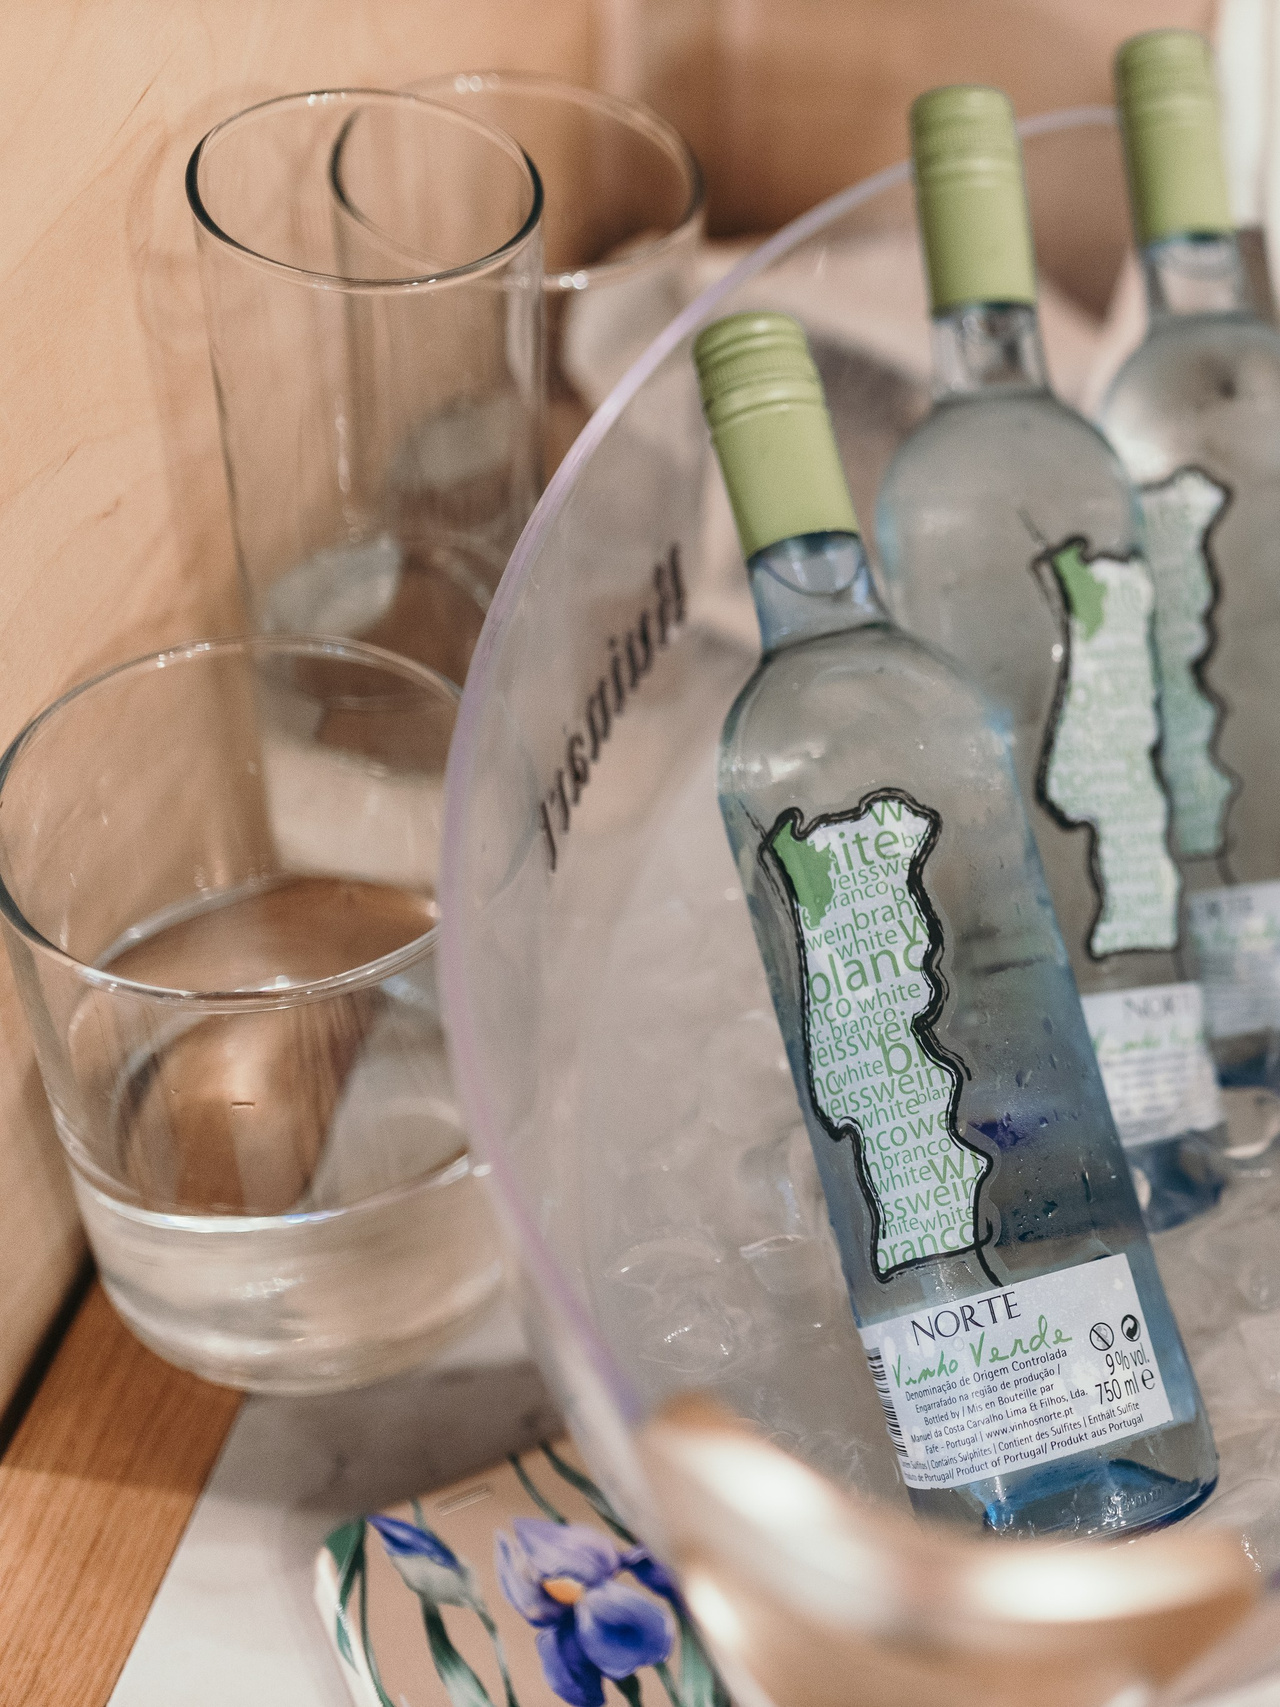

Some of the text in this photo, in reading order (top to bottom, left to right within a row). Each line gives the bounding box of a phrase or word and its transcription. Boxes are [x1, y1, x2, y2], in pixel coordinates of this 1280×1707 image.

[827, 881, 889, 912] ranco
[833, 857, 912, 890] eisswe
[857, 983, 921, 1013] white
[880, 1217, 920, 1241] hite
[911, 1291, 1021, 1346] NORTE
[892, 1314, 1073, 1388] Vinho Verde
[905, 1348, 1068, 1402] Denominação de Origem Controlada
[915, 1396, 957, 1414] Engarrafado
[959, 1394, 969, 1402] na
[971, 1384, 998, 1398] região
[1000, 1381, 1011, 1390] de
[1013, 1368, 1055, 1388] produção
[1094, 1379, 1122, 1405] 750
[1124, 1371, 1140, 1396] ml
[911, 1431, 932, 1443] Manuel
[934, 1429, 943, 1438] da
[943, 1424, 965, 1435] Costa
[966, 1414, 1004, 1429] Carvalho
[1005, 1406, 1028, 1418] Lima
[1039, 1394, 1069, 1408] Filhos,
[1069, 1388, 1088, 1400] Lda.
[924, 1412, 949, 1426] Bottled
[950, 1411, 960, 1420] by
[966, 1403, 983, 1414] Mis
[985, 1400, 996, 1409] en
[997, 1388, 1038, 1406] Bouteille
[1040, 1383, 1055, 1395] par
[925, 1444, 939, 1454] Fafe
[946, 1433, 978, 1449] Portugal
[985, 1406, 1074, 1438] www.vinhosnorte.pt
[931, 1456, 958, 1469] Contains
[958, 1447, 992, 1462] Sulphites
[998, 1435, 1033, 1451] Contient
[1035, 1430, 1050, 1441] des
[1050, 1421, 1082, 1436] Sulfites
[1116, 1402, 1140, 1416] Sulfite
[956, 1461, 989, 1476] Product
[991, 1457, 1001, 1468] of
[1050, 1432, 1089, 1451] Produkt
[1090, 1427, 1108, 1438] aus
[1108, 1413, 1145, 1432] Portugal
